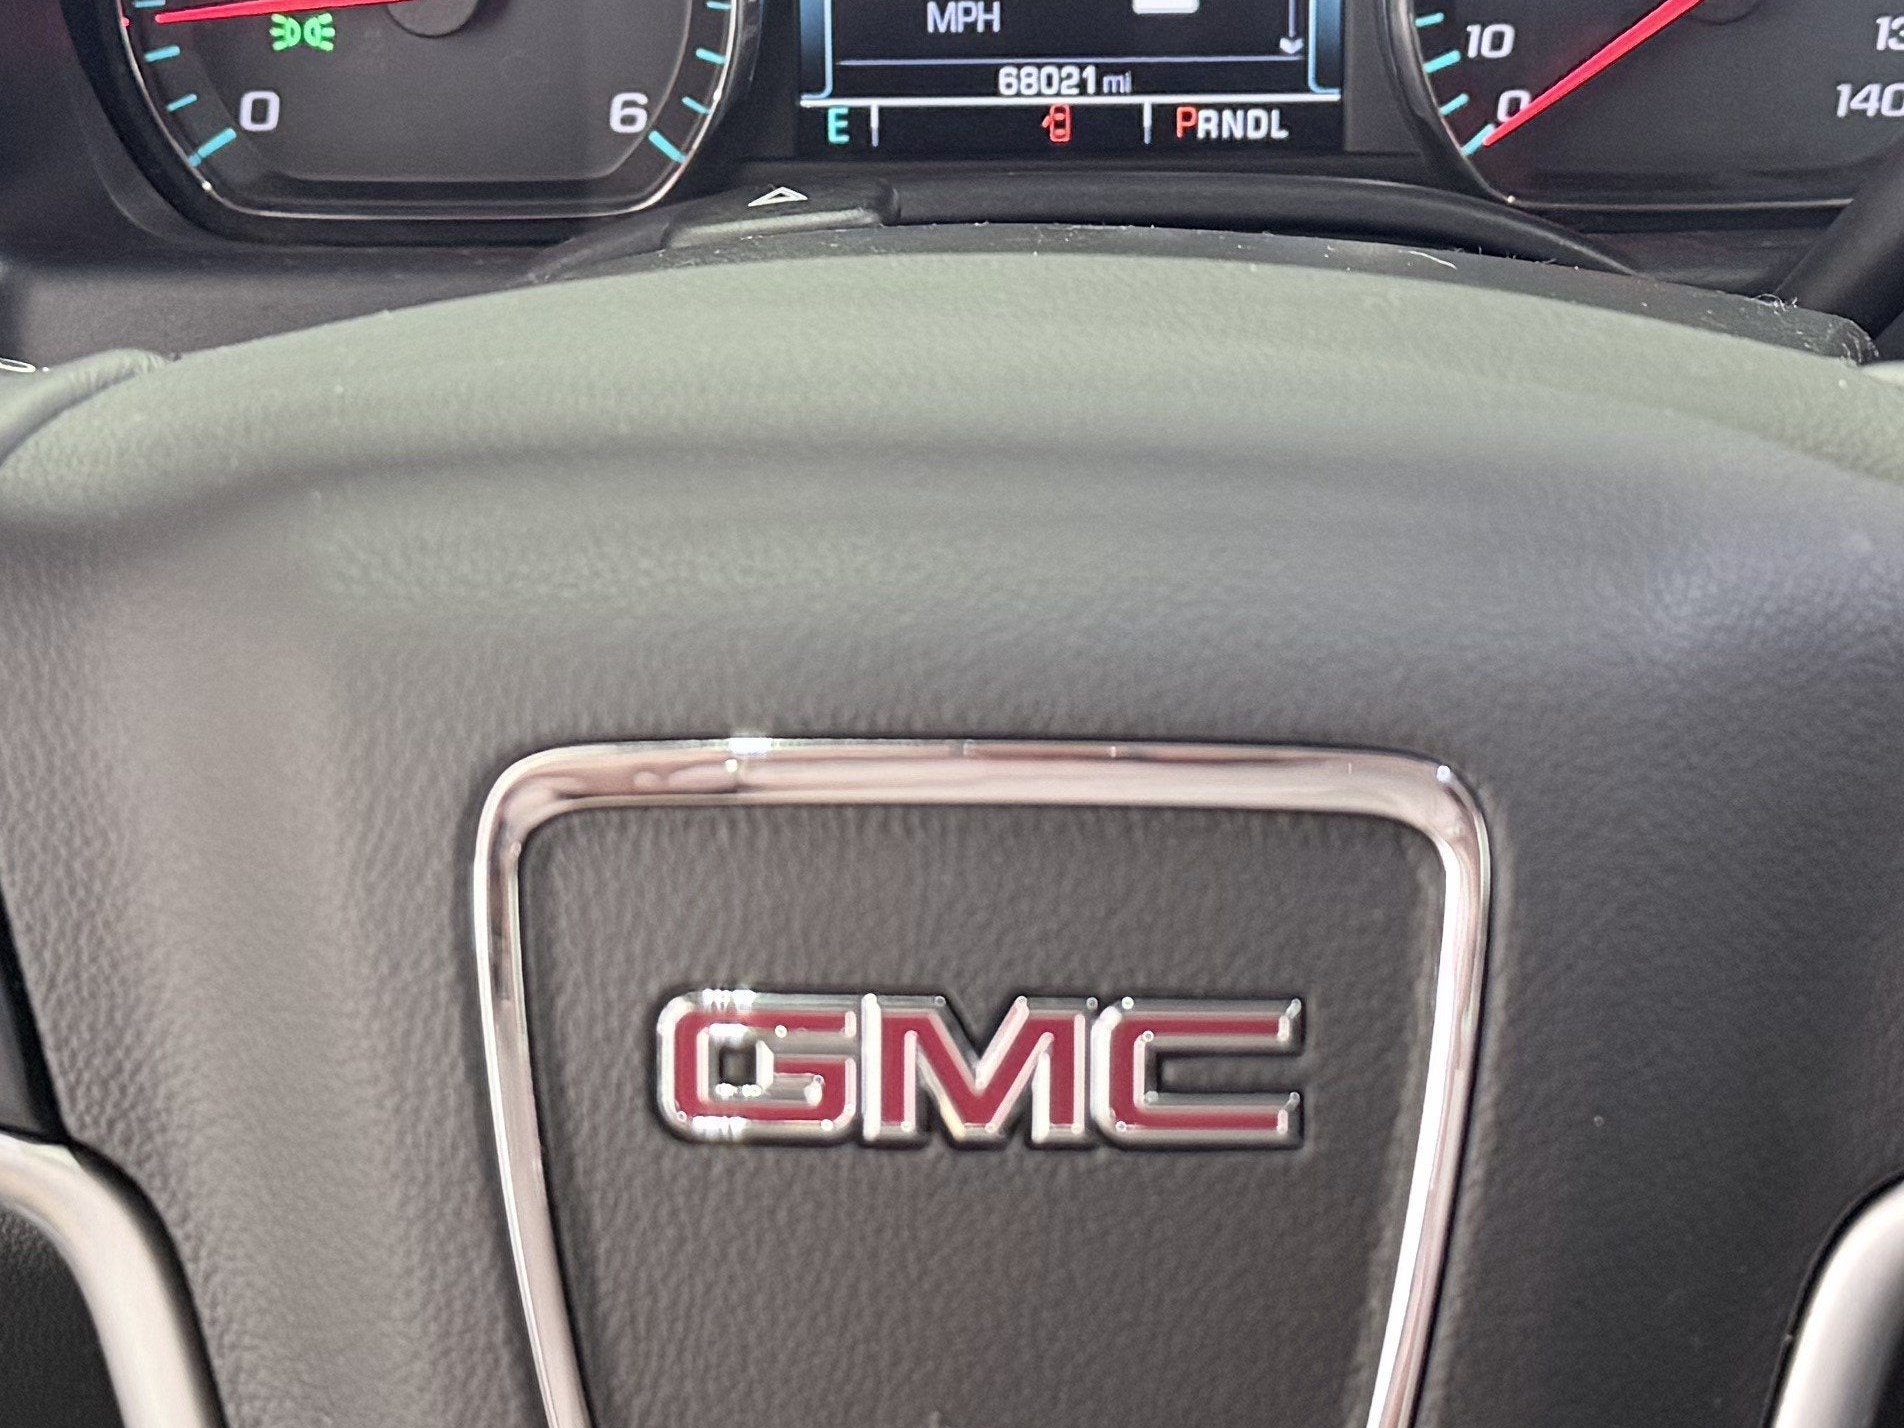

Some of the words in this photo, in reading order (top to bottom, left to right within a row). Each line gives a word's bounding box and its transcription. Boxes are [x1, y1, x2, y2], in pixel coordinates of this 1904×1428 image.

[926, 0, 1001, 34] MPH
[1466, 23, 1515, 59] 10
[998, 65, 1096, 96] 68021
[1102, 71, 1133, 95] mi
[239, 90, 280, 132] 0
[609, 92, 649, 134] 6
[1176, 105, 1289, 140] PRNDL
[1496, 91, 1530, 123] 0
[825, 106, 850, 146] E
[656, 992, 1301, 1147] GMC
